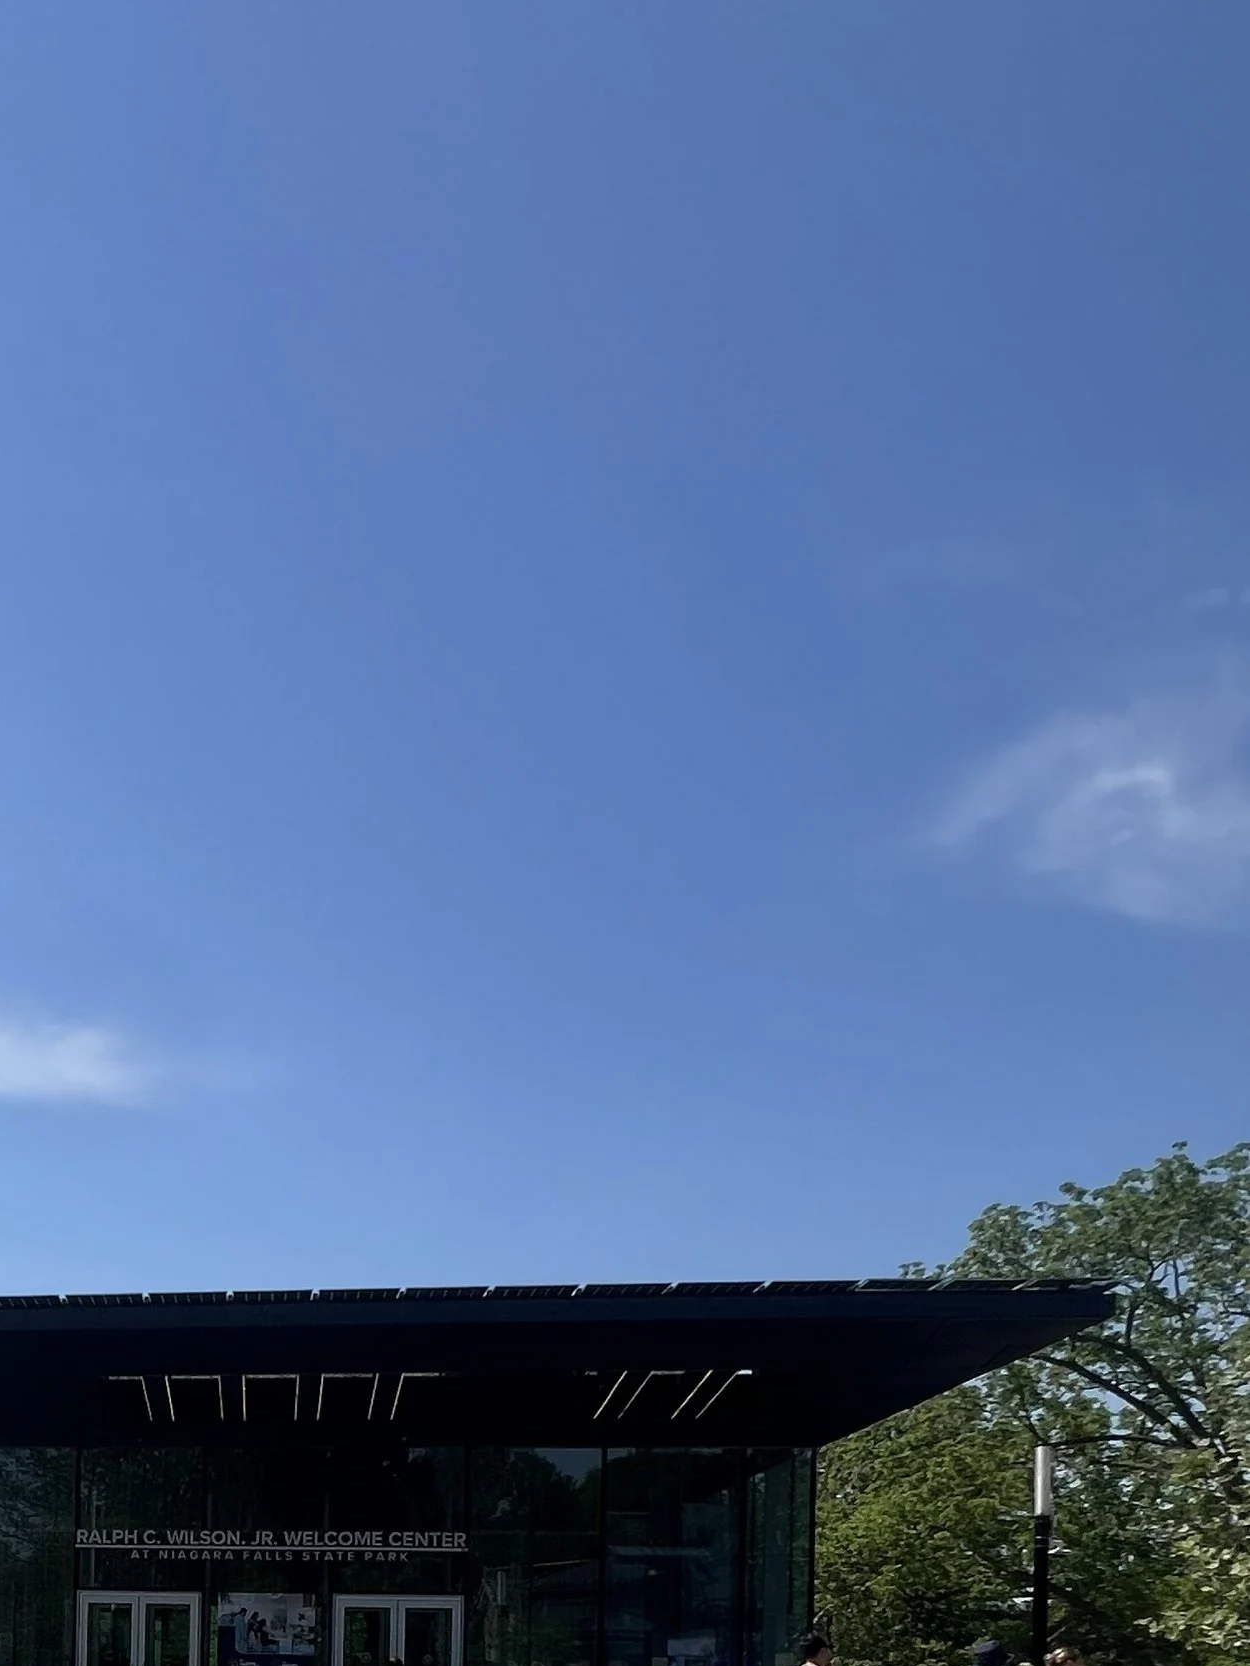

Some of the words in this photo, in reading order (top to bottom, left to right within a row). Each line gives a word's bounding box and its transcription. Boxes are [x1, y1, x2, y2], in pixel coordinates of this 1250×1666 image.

[76, 1529, 137, 1544] RALPH
[142, 1529, 161, 1544] C.
[251, 1530, 278, 1545] JR.
[283, 1530, 383, 1546] WELCOME
[388, 1531, 467, 1547] CENTER
[131, 1550, 149, 1559] AT
[159, 1550, 234, 1560] NIAGARA
[243, 1551, 293, 1561] FALLS
[302, 1551, 355, 1561] STATE
[365, 1552, 409, 1562] PARK
